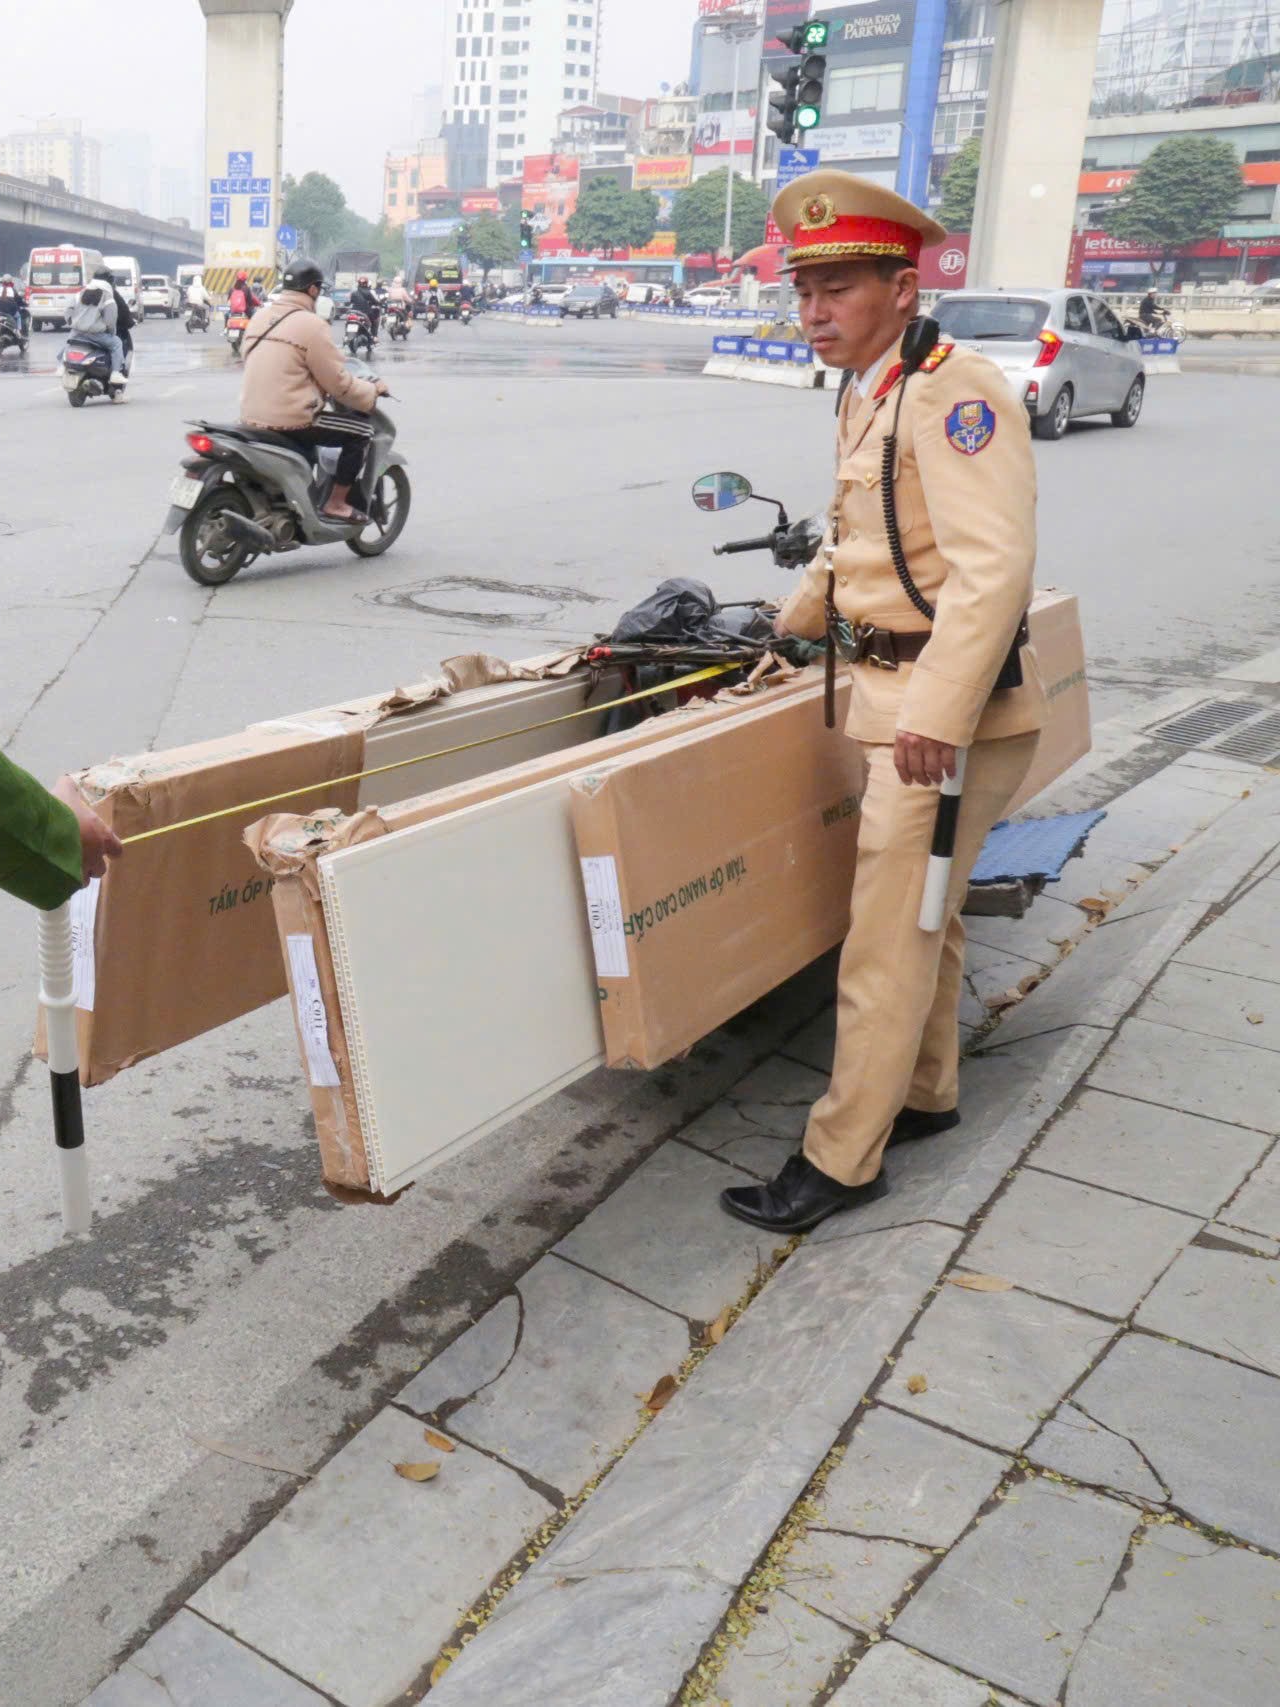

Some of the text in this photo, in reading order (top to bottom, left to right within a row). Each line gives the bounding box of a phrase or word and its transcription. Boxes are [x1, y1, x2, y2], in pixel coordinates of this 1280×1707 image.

[843, 22, 901, 40] PARKWAY
[853, 13, 901, 26] NHA KHOA
[807, 27, 825, 43] 22
[208, 883, 238, 916] TẤM
[242, 875, 263, 903] ỐP
[678, 875, 708, 907] NANO
[655, 893, 677, 922] CAO
